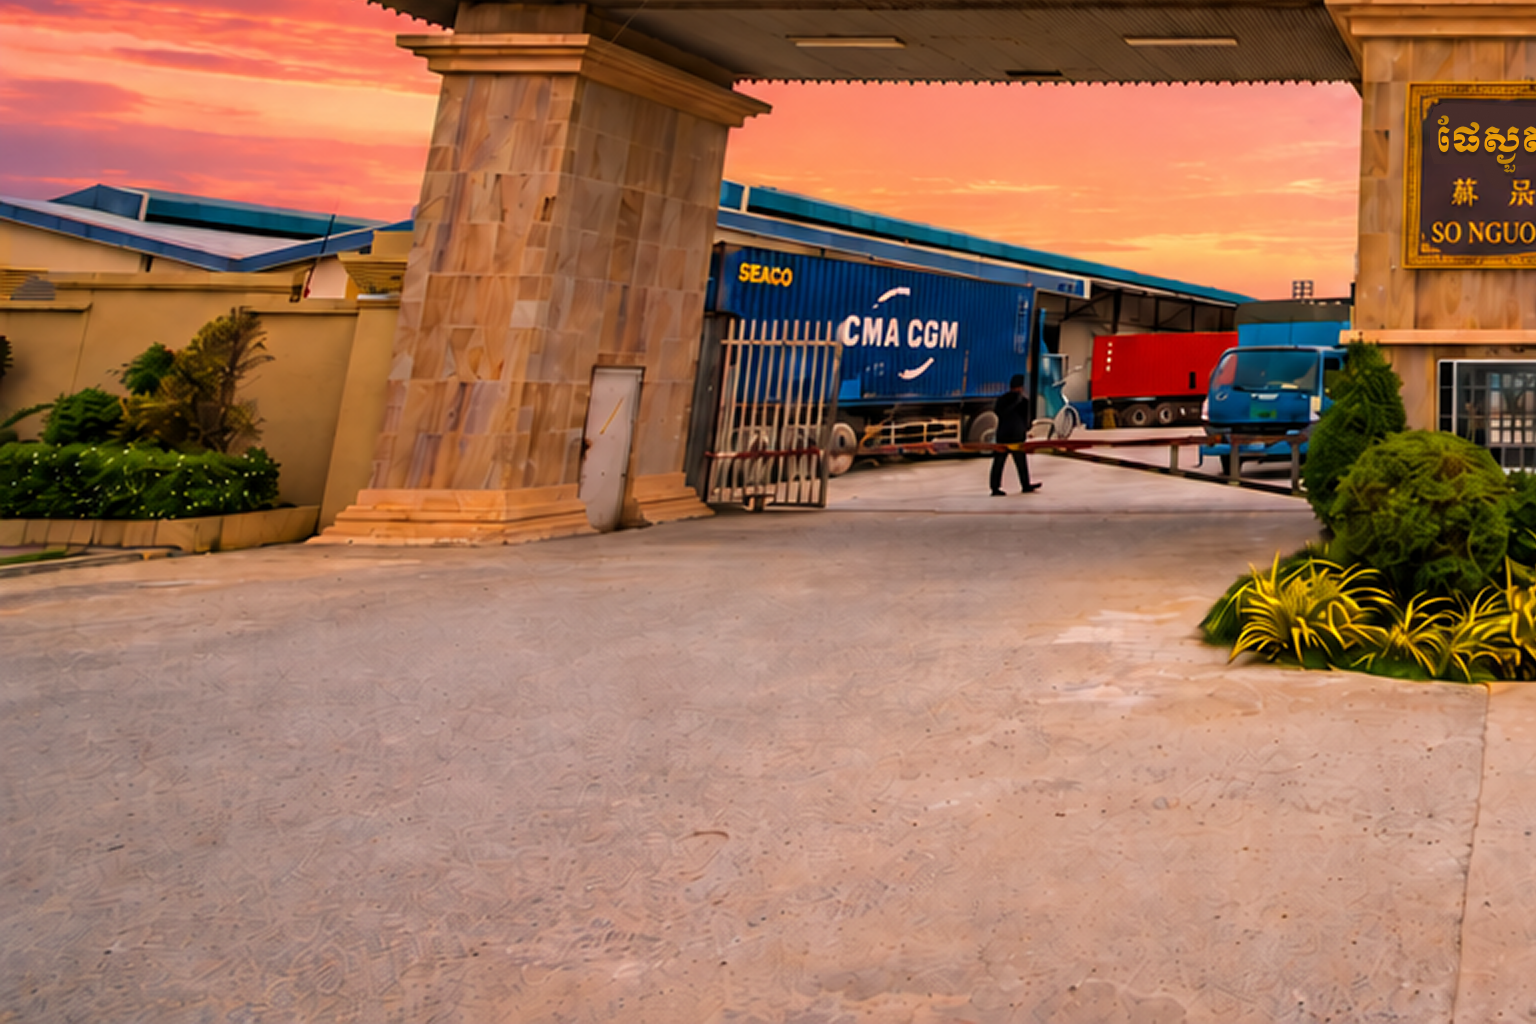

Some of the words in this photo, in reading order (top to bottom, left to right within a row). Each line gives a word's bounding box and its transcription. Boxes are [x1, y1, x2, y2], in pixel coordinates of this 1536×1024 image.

[1431, 221, 1462, 243] SO
[738, 262, 794, 288] SEACO
[842, 314, 900, 348] CMA
[907, 318, 959, 349] CGM
